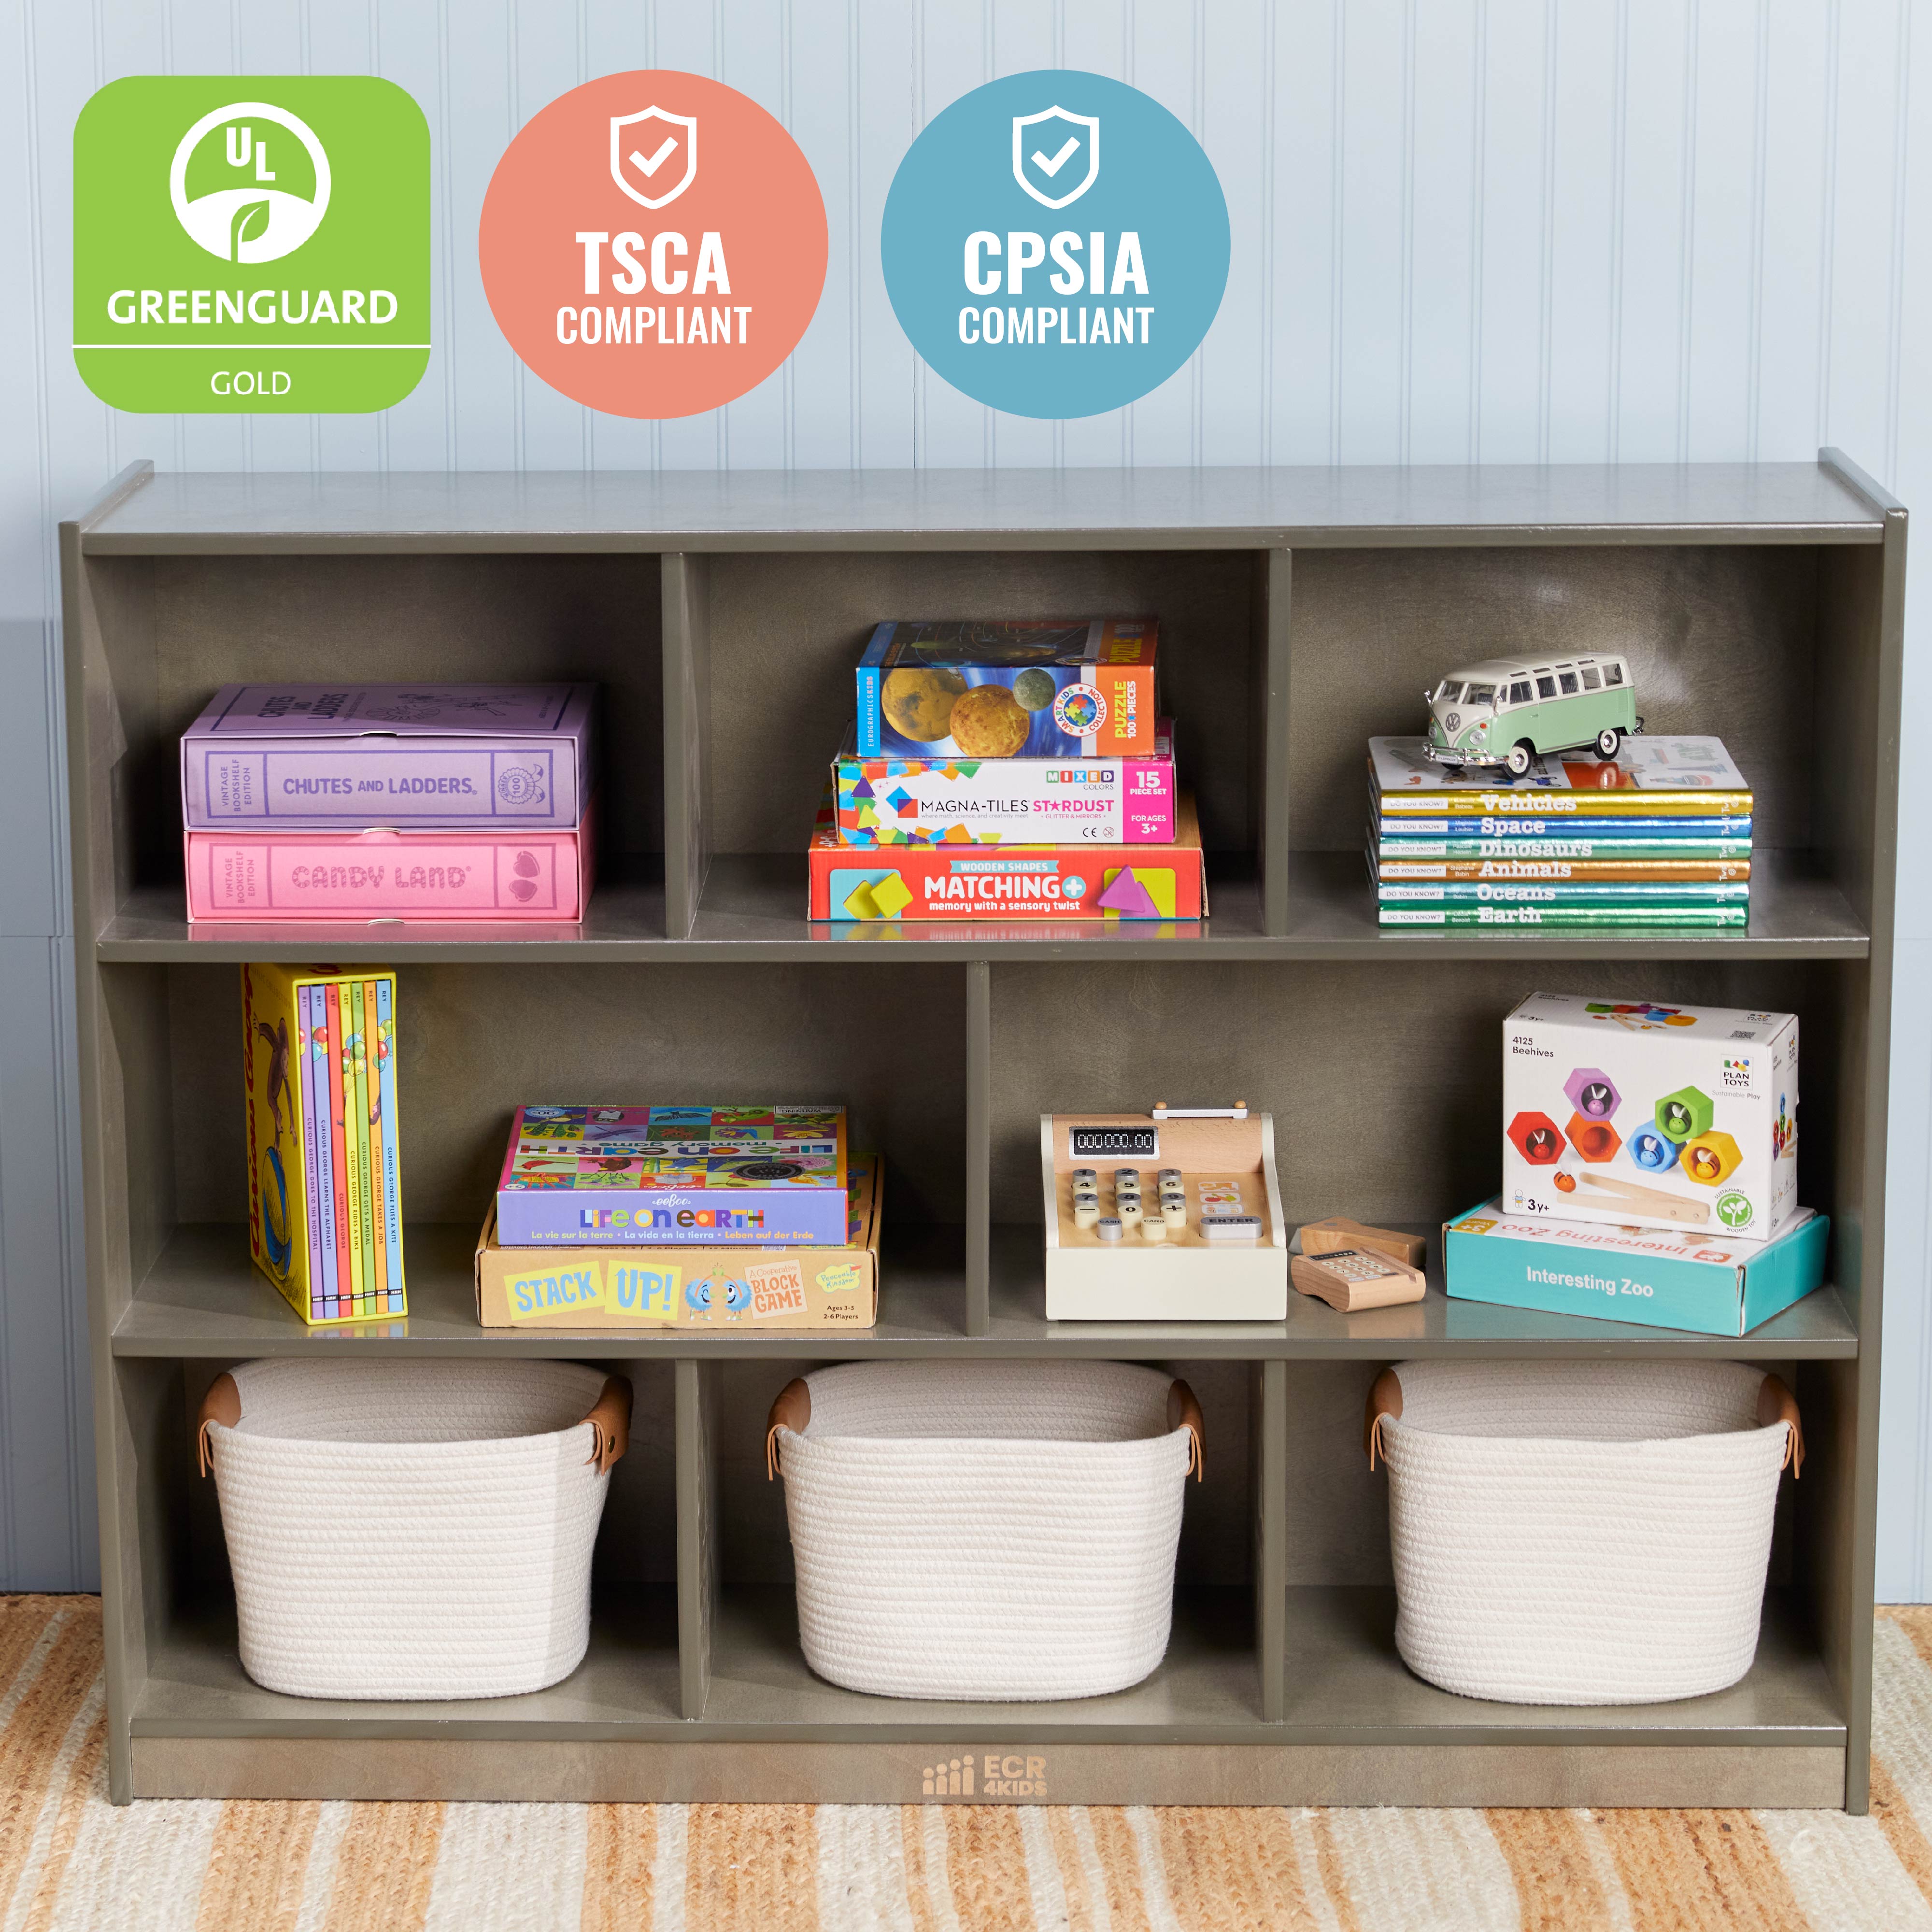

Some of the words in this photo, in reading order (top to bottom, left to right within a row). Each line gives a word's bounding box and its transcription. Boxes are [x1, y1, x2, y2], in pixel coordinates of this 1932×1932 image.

[1057, 688, 1074, 704] KIDS
[1127, 681, 1136, 714] PIECES
[1088, 689, 1105, 731] COLLECTION
[1115, 681, 1126, 738] PUZZLE
[1055, 706, 1074, 733] SMART
[1127, 722, 1136, 739] 100
[1046, 770, 1114, 782] MIXED
[1136, 771, 1160, 788] 15
[221, 766, 229, 806] VINTAGE
[232, 759, 241, 811] BOOKSHELF
[243, 767, 252, 805] EDITION
[283, 778, 353, 794] CHUTES
[358, 781, 384, 792] AND
[921, 800, 1028, 812] MAGNA-TILES
[1480, 793, 1577, 811] Vehicles
[1141, 824, 1158, 834] 3+
[1481, 817, 1546, 837] Space
[1478, 839, 1592, 857] Dinosaurs
[961, 863, 1005, 871] WOODEN
[1008, 863, 1048, 871] SHAPES
[1478, 860, 1572, 877] Animals
[236, 851, 245, 903] BOOKSHELF
[1477, 883, 1556, 900] Oceans
[929, 902, 971, 912] memory
[974, 901, 997, 910] with
[1009, 902, 1050, 912] sensory
[1053, 901, 1080, 910] twist
[1477, 907, 1542, 923] Earth
[1512, 1037, 1533, 1045] 4125
[1513, 1046, 1554, 1057] Beehives
[1715, 1188, 1745, 1199] SUSTAINABLE
[1528, 1199, 1550, 1213] 3y+
[1502, 1224, 1549, 1237] Zoo
[1555, 1229, 1689, 1255] Interesting
[756, 1265, 797, 1277] Cooperative
[821, 1271, 856, 1281] Peaceable
[514, 1271, 597, 1312] STACK
[616, 1267, 673, 1311] UP!
[751, 1274, 799, 1294] BLOCK
[826, 1279, 854, 1288] Kingdom
[1527, 1266, 1616, 1296] Interesting
[1621, 1279, 1654, 1297] Zoo
[754, 1289, 802, 1313] GAME
[984, 1756, 1046, 1778] ECR
[983, 1780, 1048, 1796] 4KIDS
